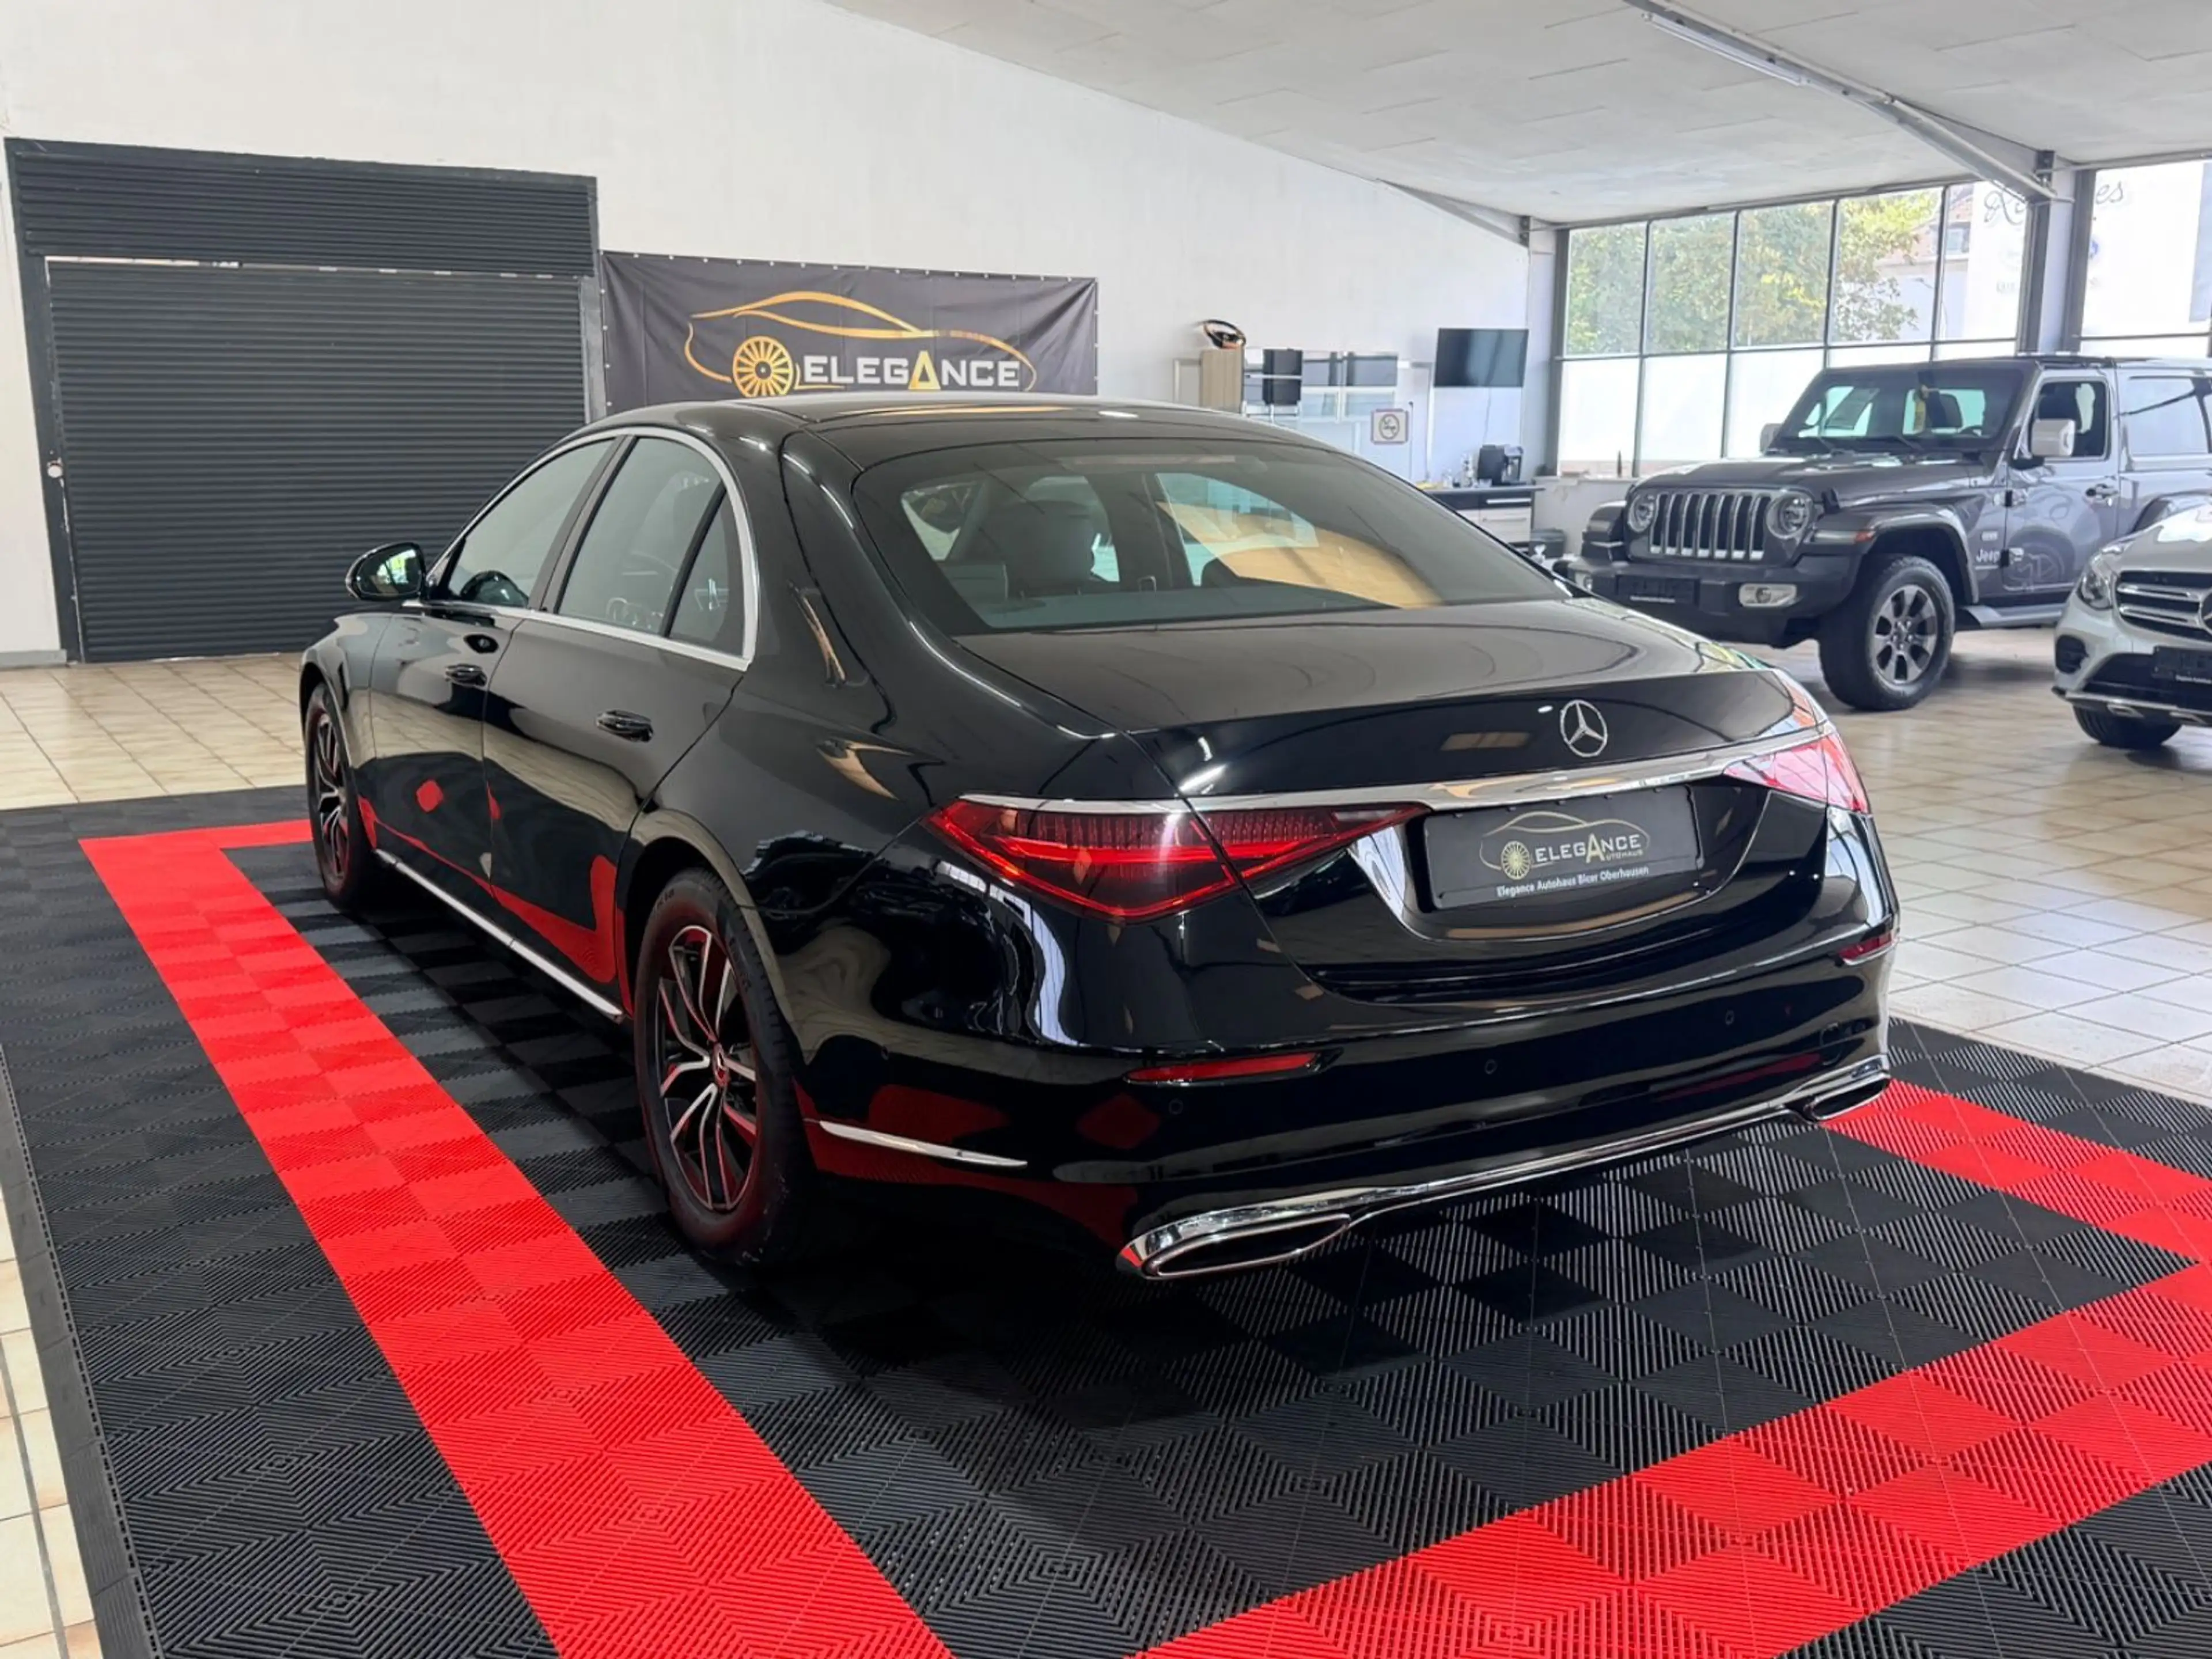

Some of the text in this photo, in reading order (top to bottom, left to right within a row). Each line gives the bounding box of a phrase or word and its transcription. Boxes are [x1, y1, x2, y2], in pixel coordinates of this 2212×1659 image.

[803, 350, 1020, 390] ELEGANCE
[1535, 833, 1641, 863] ELEGANCE
[1497, 884, 1535, 898] Elegance
[1536, 877, 1576, 891] Autohaus
[1600, 866, 1649, 881] Oberhausen
